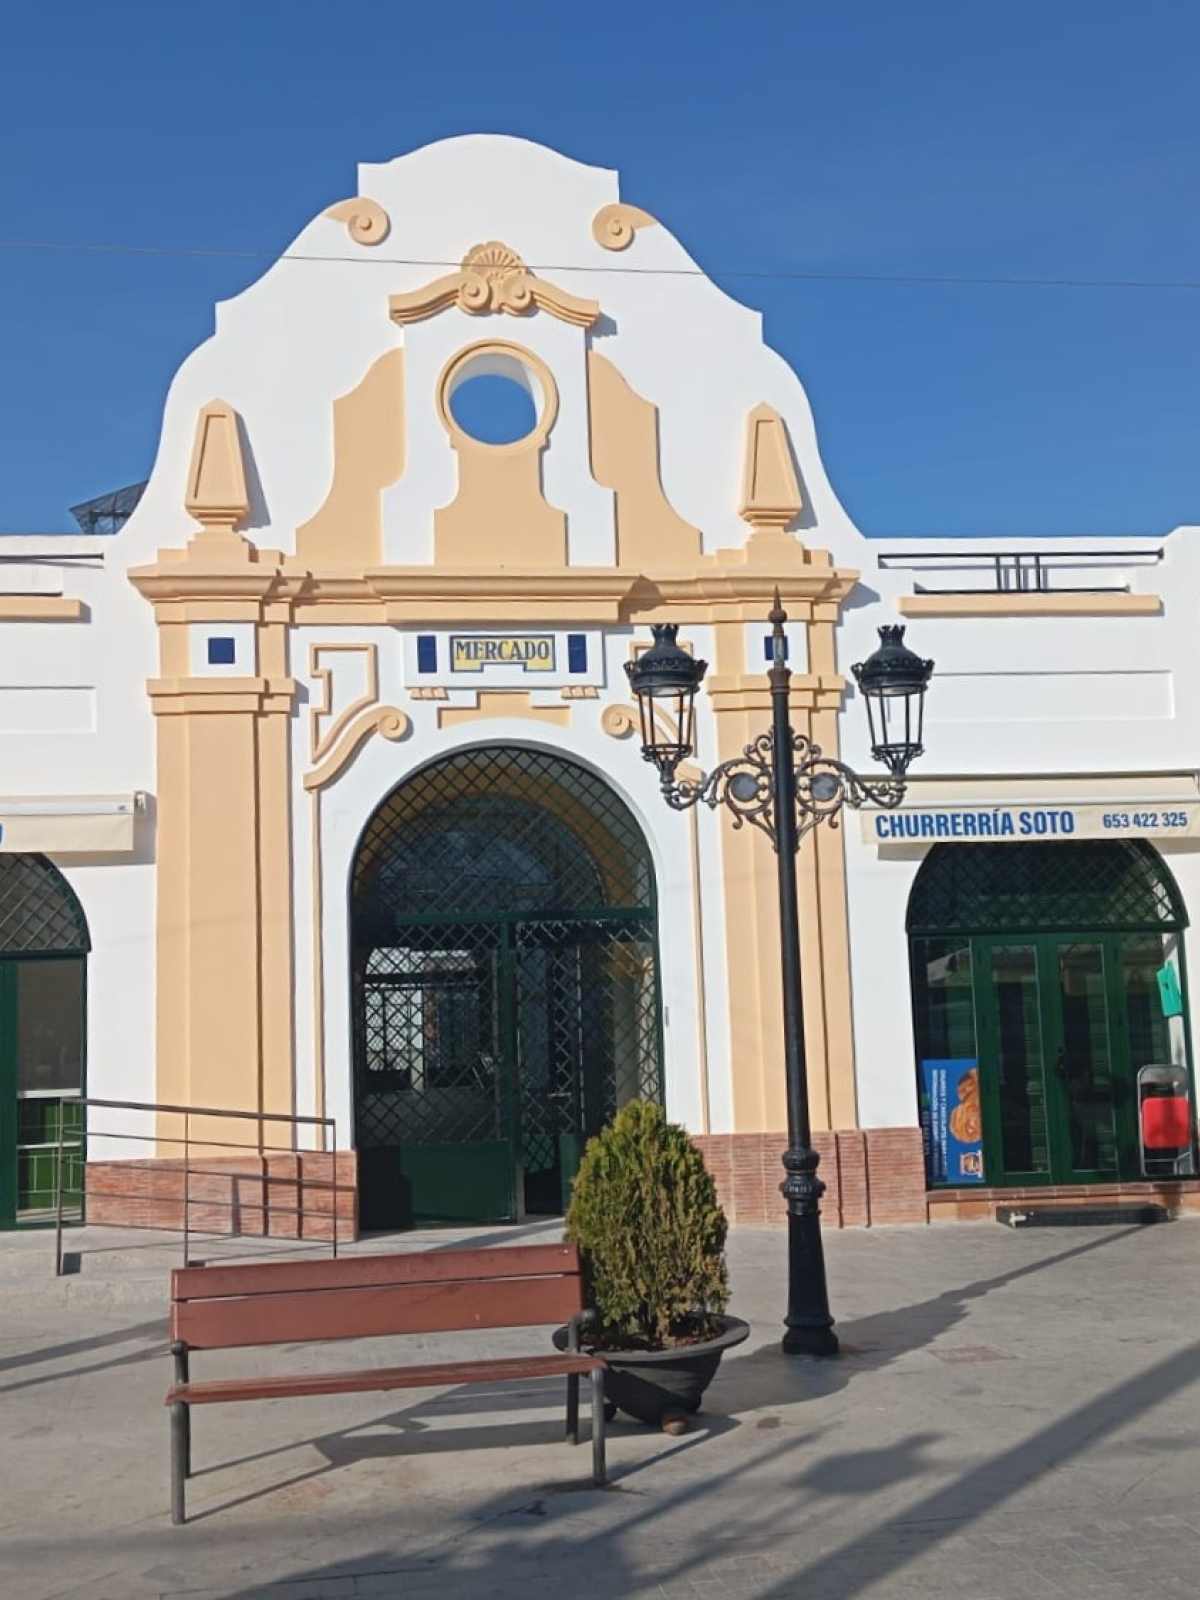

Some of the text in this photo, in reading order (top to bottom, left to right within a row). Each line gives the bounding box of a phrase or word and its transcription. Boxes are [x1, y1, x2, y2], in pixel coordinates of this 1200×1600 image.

[455, 640, 550, 661] MERCADO
[875, 808, 1075, 838] CHURRERRÍA SOTO
[1103, 811, 1188, 828] 653 422 325
